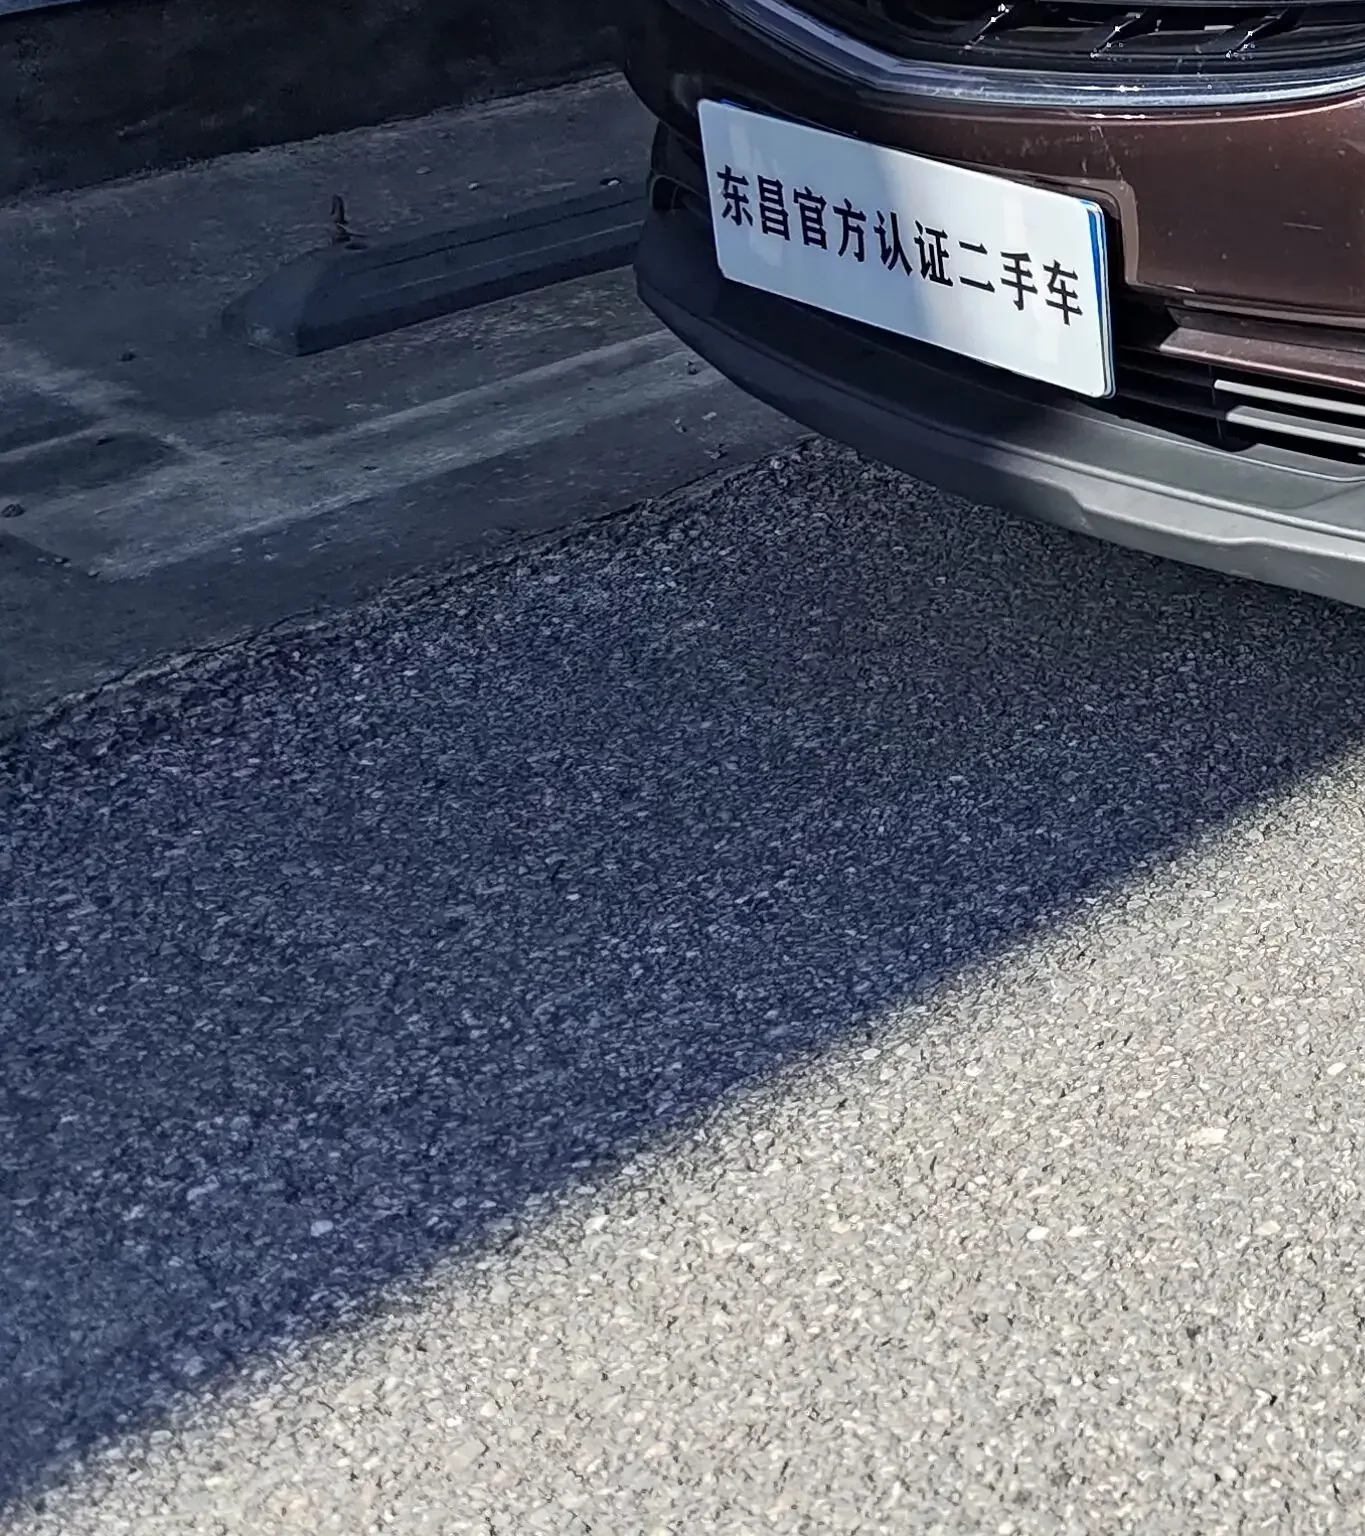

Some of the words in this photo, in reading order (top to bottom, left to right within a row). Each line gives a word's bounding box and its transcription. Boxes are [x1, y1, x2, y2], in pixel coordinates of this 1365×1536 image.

[716, 165, 1084, 326] 东昌官方认证二手车
